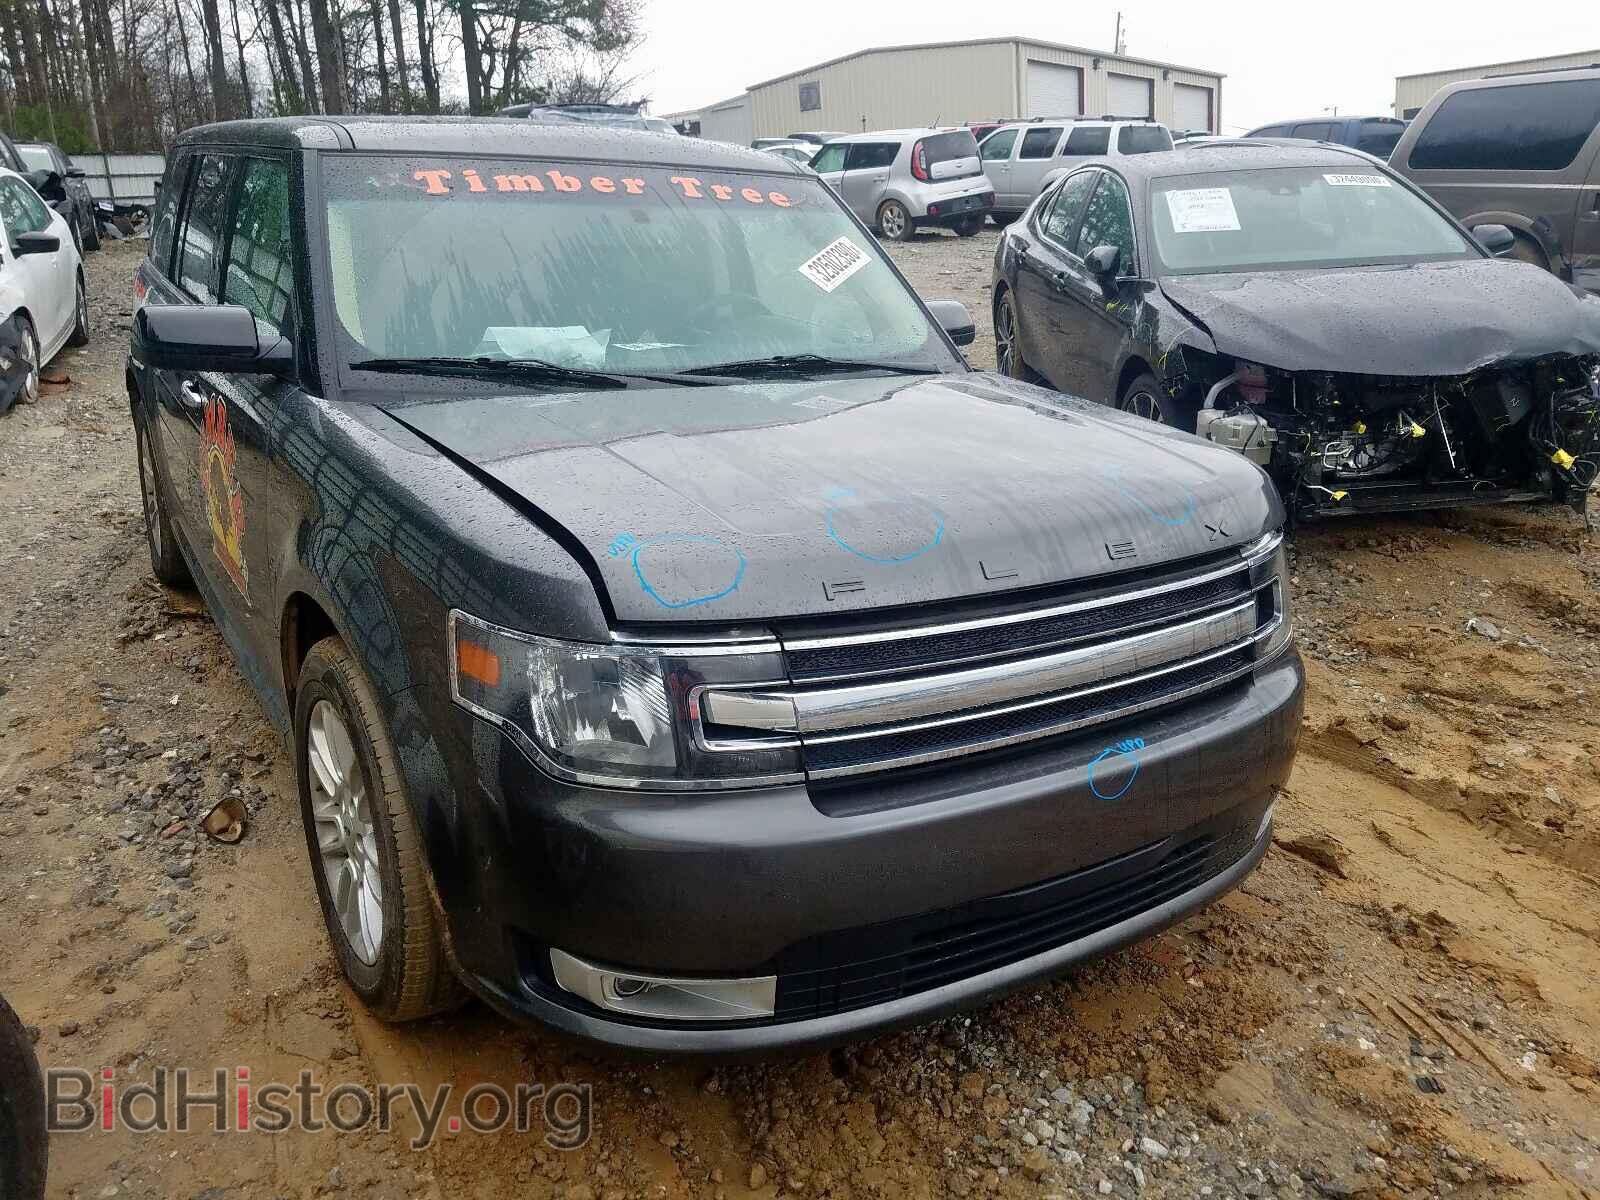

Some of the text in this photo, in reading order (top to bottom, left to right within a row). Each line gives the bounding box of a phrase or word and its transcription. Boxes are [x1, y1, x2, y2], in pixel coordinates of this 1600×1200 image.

[413, 168, 792, 208] Timber Tree
[807, 241, 862, 283] 32502390
